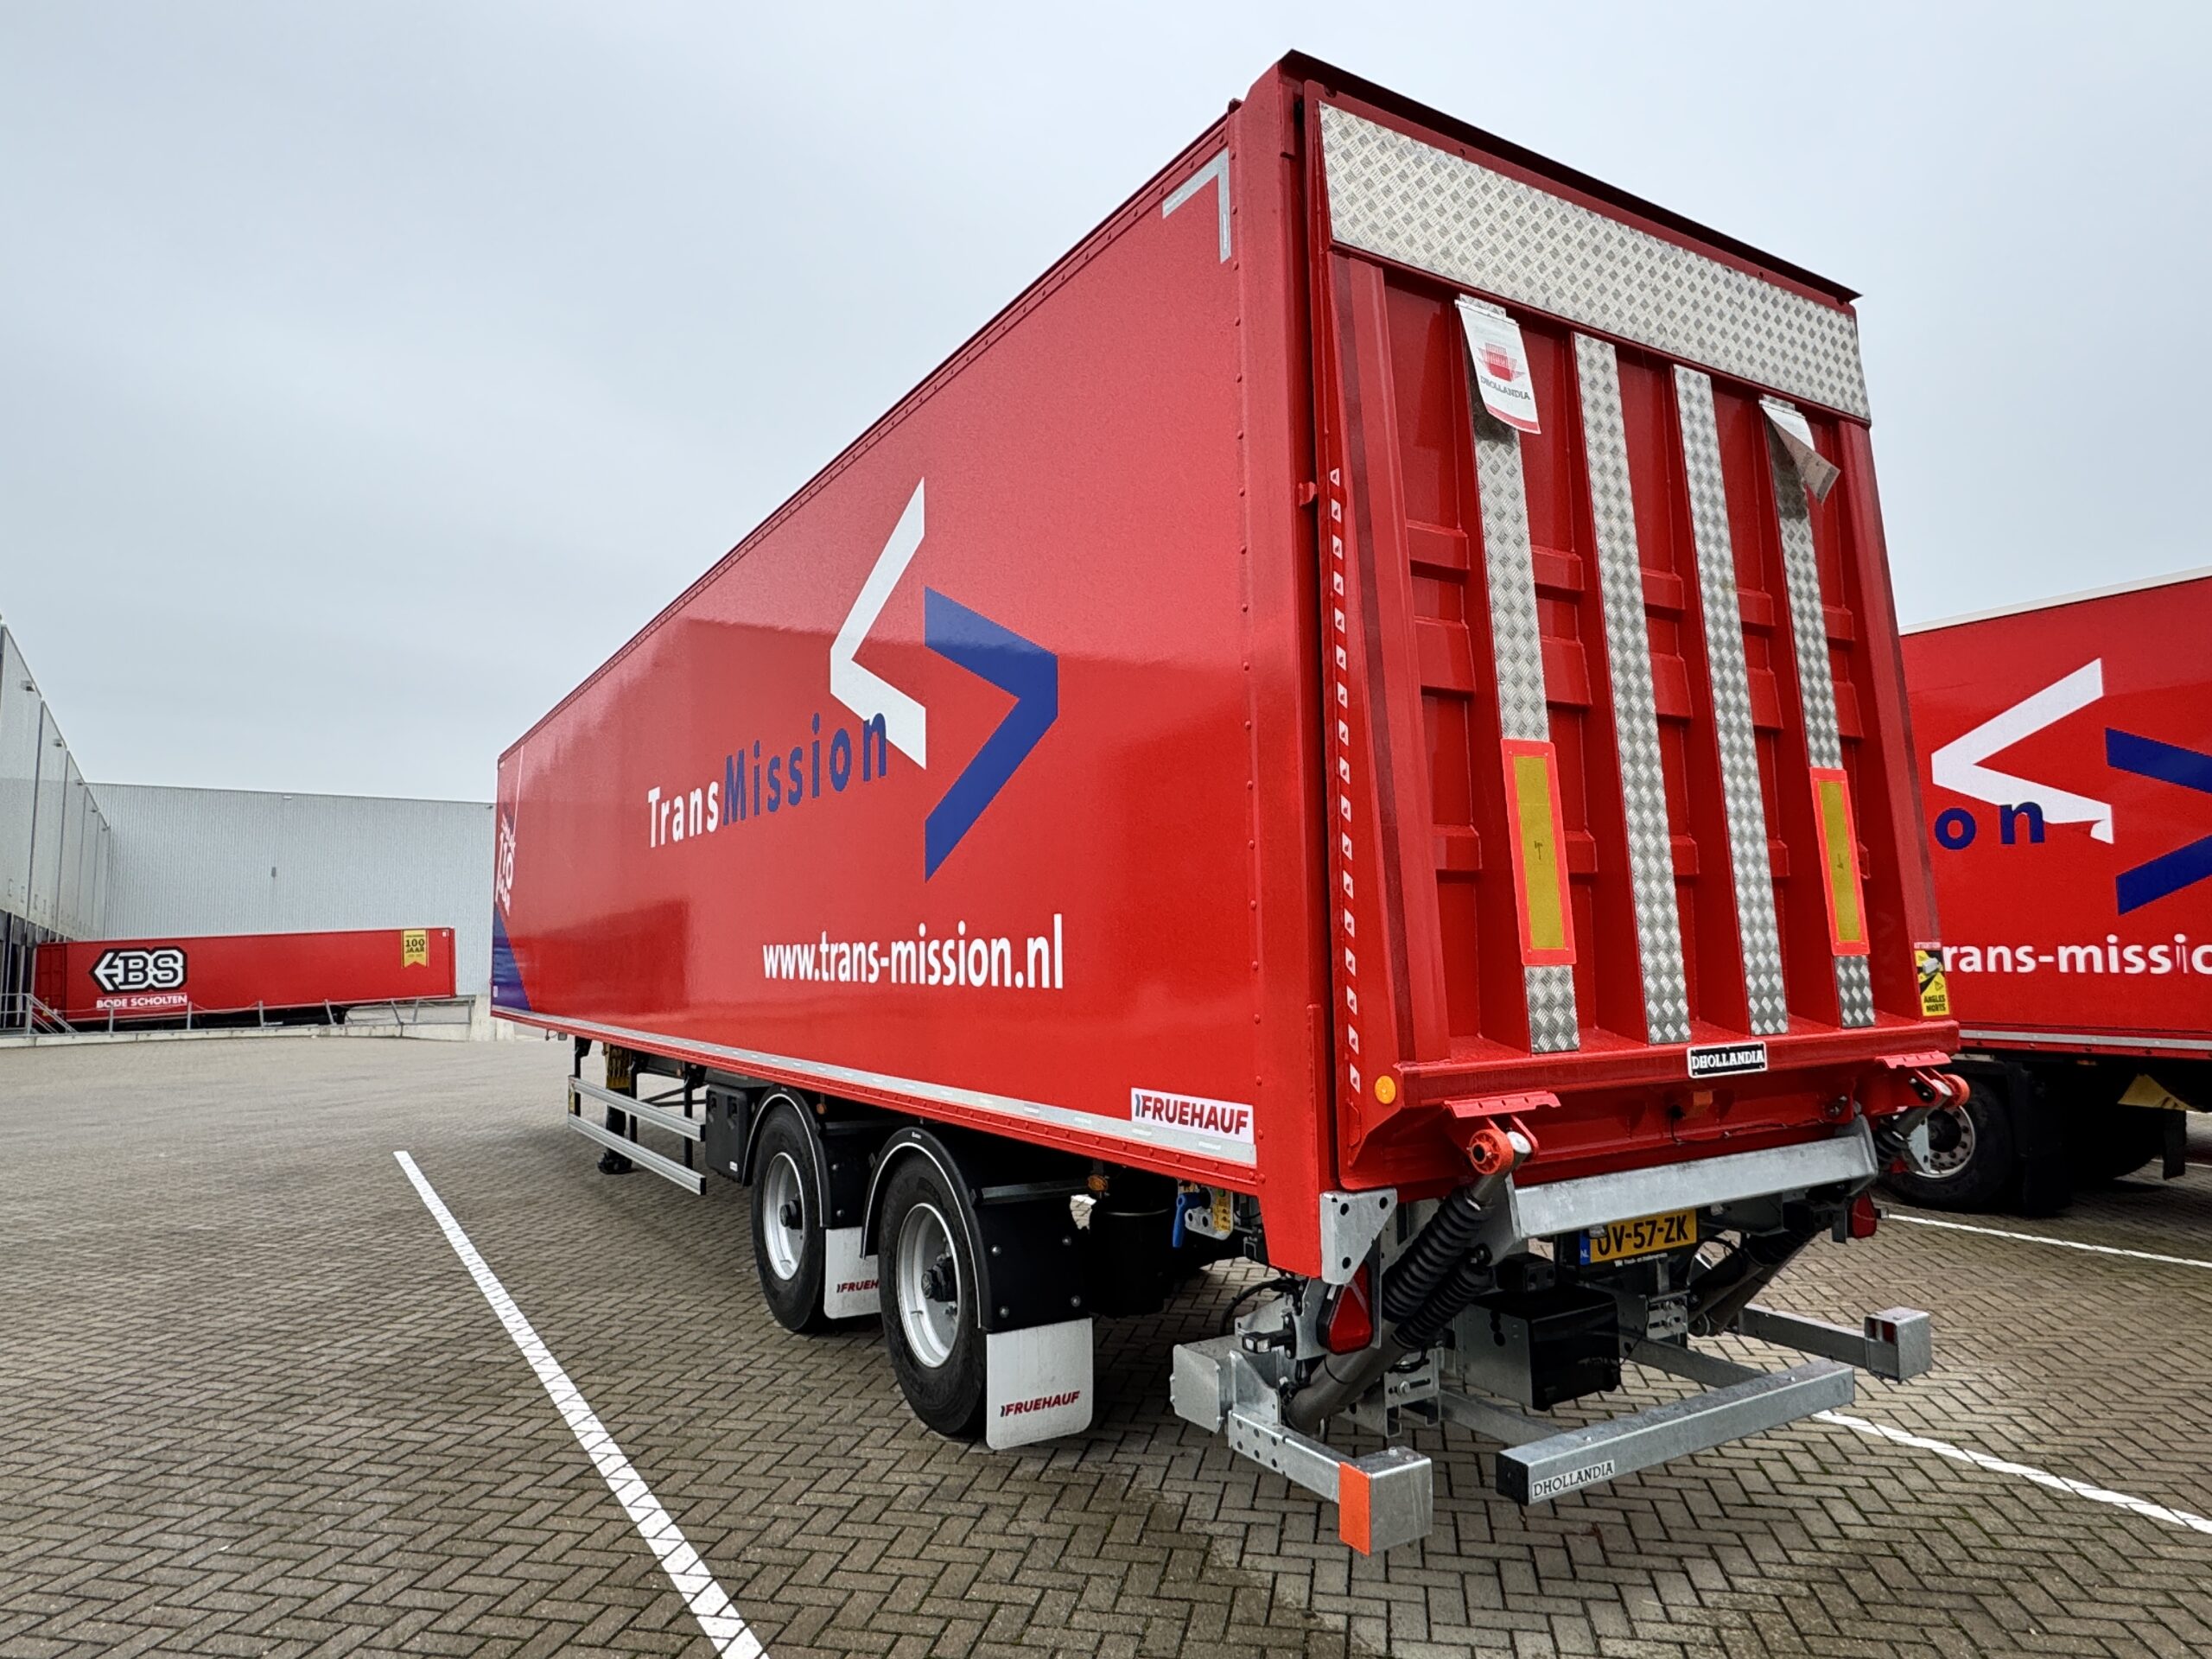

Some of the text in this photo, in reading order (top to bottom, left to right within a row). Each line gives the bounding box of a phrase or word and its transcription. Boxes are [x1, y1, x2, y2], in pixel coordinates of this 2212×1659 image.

[1480, 375, 1531, 400] DHOLLANDIA
[405, 938, 425, 947] 100
[763, 913, 1064, 989] www.trans-mission.nl
[96, 995, 188, 1008] BODE SCHOLTEN
[1691, 1050, 1764, 1069] DHOLLANDIA
[1140, 1094, 1249, 1135] FRUEHAUF
[839, 1279, 880, 1294] FRUEH
[1004, 1390, 1080, 1417] FRUEHAUF
[1533, 1462, 1613, 1497] DHOLLANDIA
